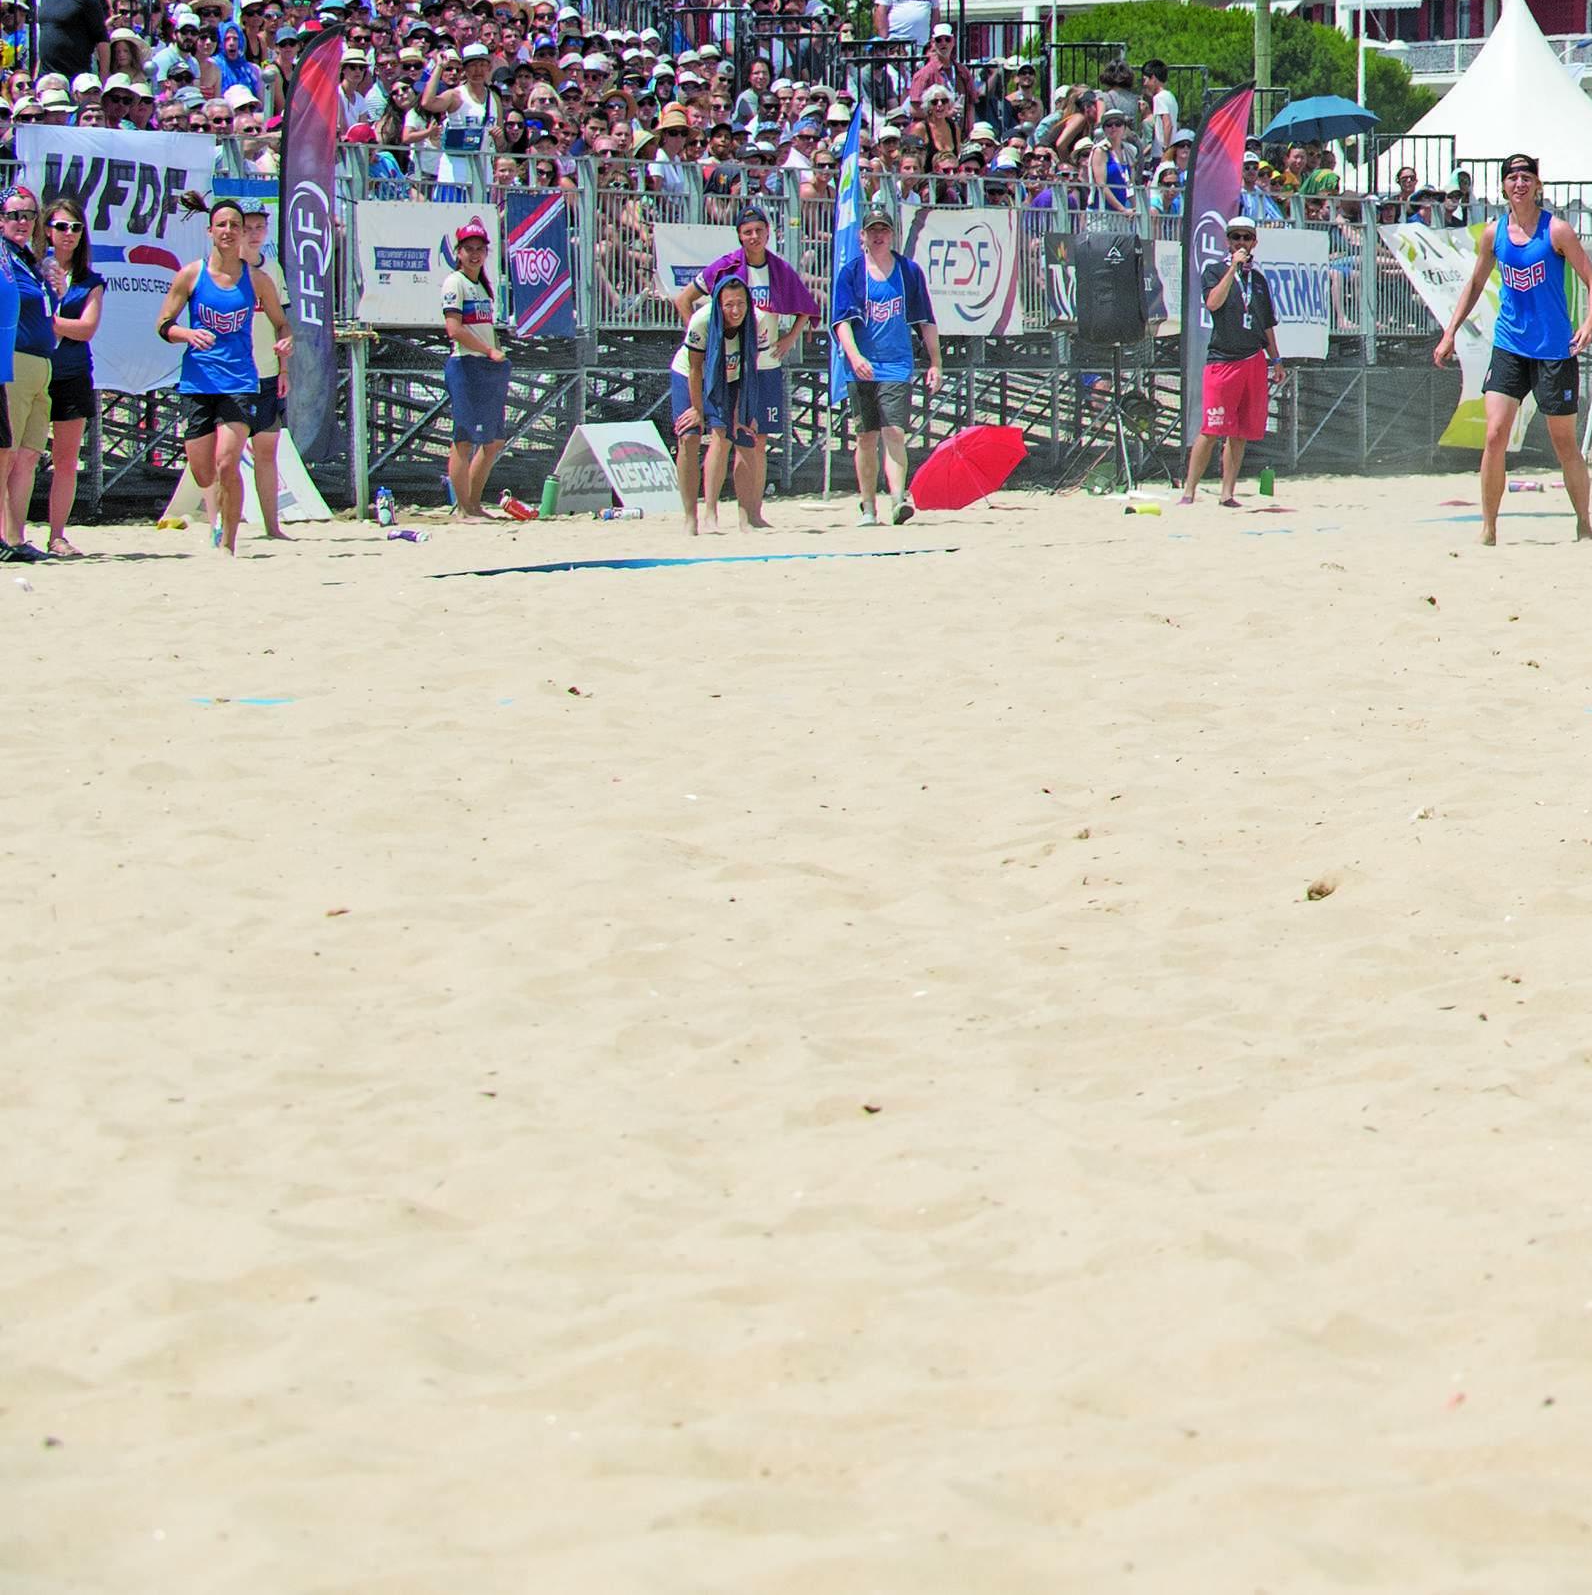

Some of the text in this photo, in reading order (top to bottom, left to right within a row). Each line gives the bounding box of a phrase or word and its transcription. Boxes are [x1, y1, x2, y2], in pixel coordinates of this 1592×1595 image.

[41, 153, 187, 239] WFDF
[929, 240, 991, 287] FFDF
[1499, 260, 1546, 292] USA
[198, 302, 249, 335] USA
[767, 406, 779, 423] 12
